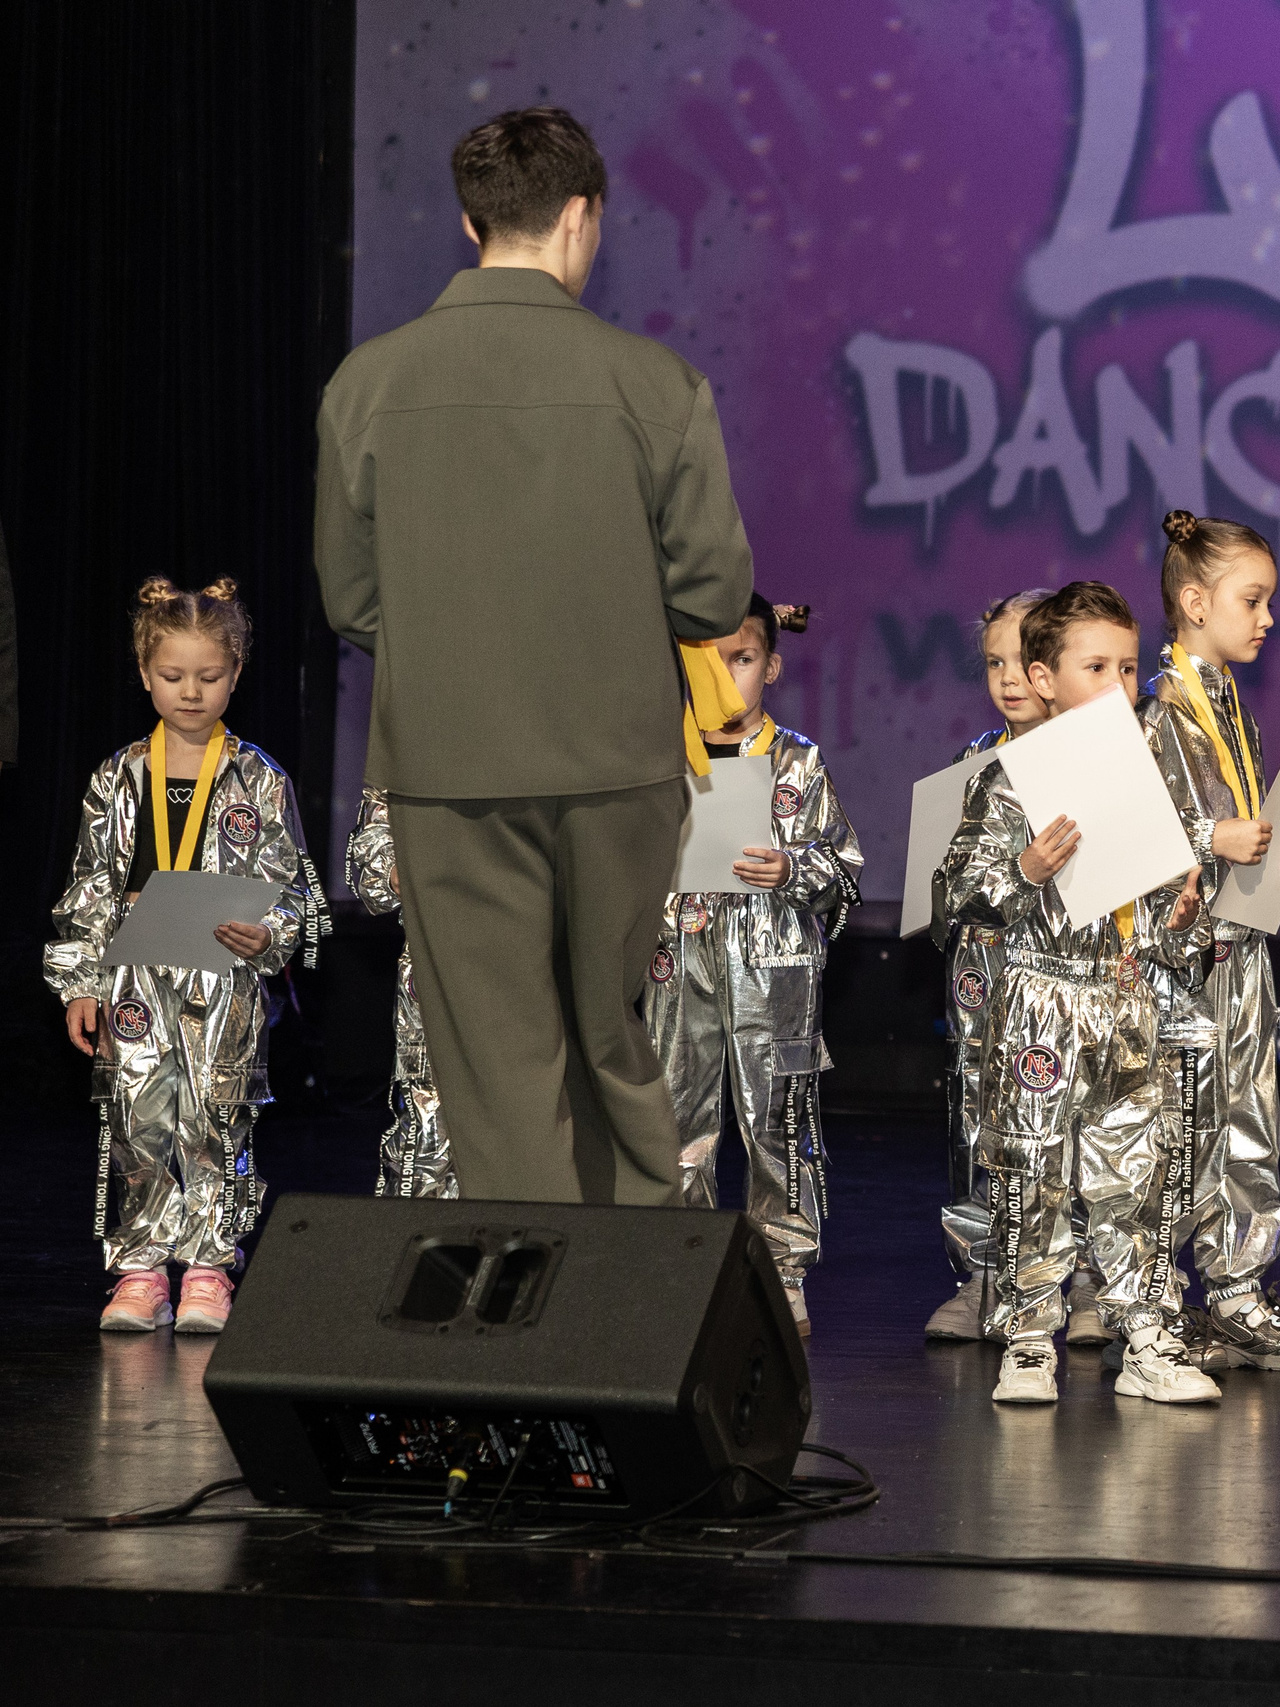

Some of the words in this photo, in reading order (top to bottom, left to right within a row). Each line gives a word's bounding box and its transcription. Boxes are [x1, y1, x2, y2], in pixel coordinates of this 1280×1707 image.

[306, 917, 318, 943] TOUY
[1183, 1073, 1195, 1110] Fashion
[407, 1119, 417, 1145] TOUY
[787, 1108, 798, 1135] style
[1184, 1115, 1195, 1138] style
[98, 1152, 110, 1178] TOUY
[225, 1154, 235, 1181] TOUY
[403, 1149, 415, 1175] TONG
[788, 1140, 799, 1175] Fashion
[1182, 1143, 1193, 1188] Fashion
[96, 1183, 107, 1209] TONG
[224, 1185, 235, 1211] TONG
[401, 1177, 413, 1197] TOU
[789, 1181, 799, 1209] style
[1008, 1195, 1021, 1225] TOUY
[1161, 1189, 1173, 1218] TONG
[94, 1210, 105, 1237] TOUY
[1158, 1218, 1173, 1249] TOUY
[1008, 1227, 1021, 1256] TONG
[1153, 1252, 1169, 1282] TONG
